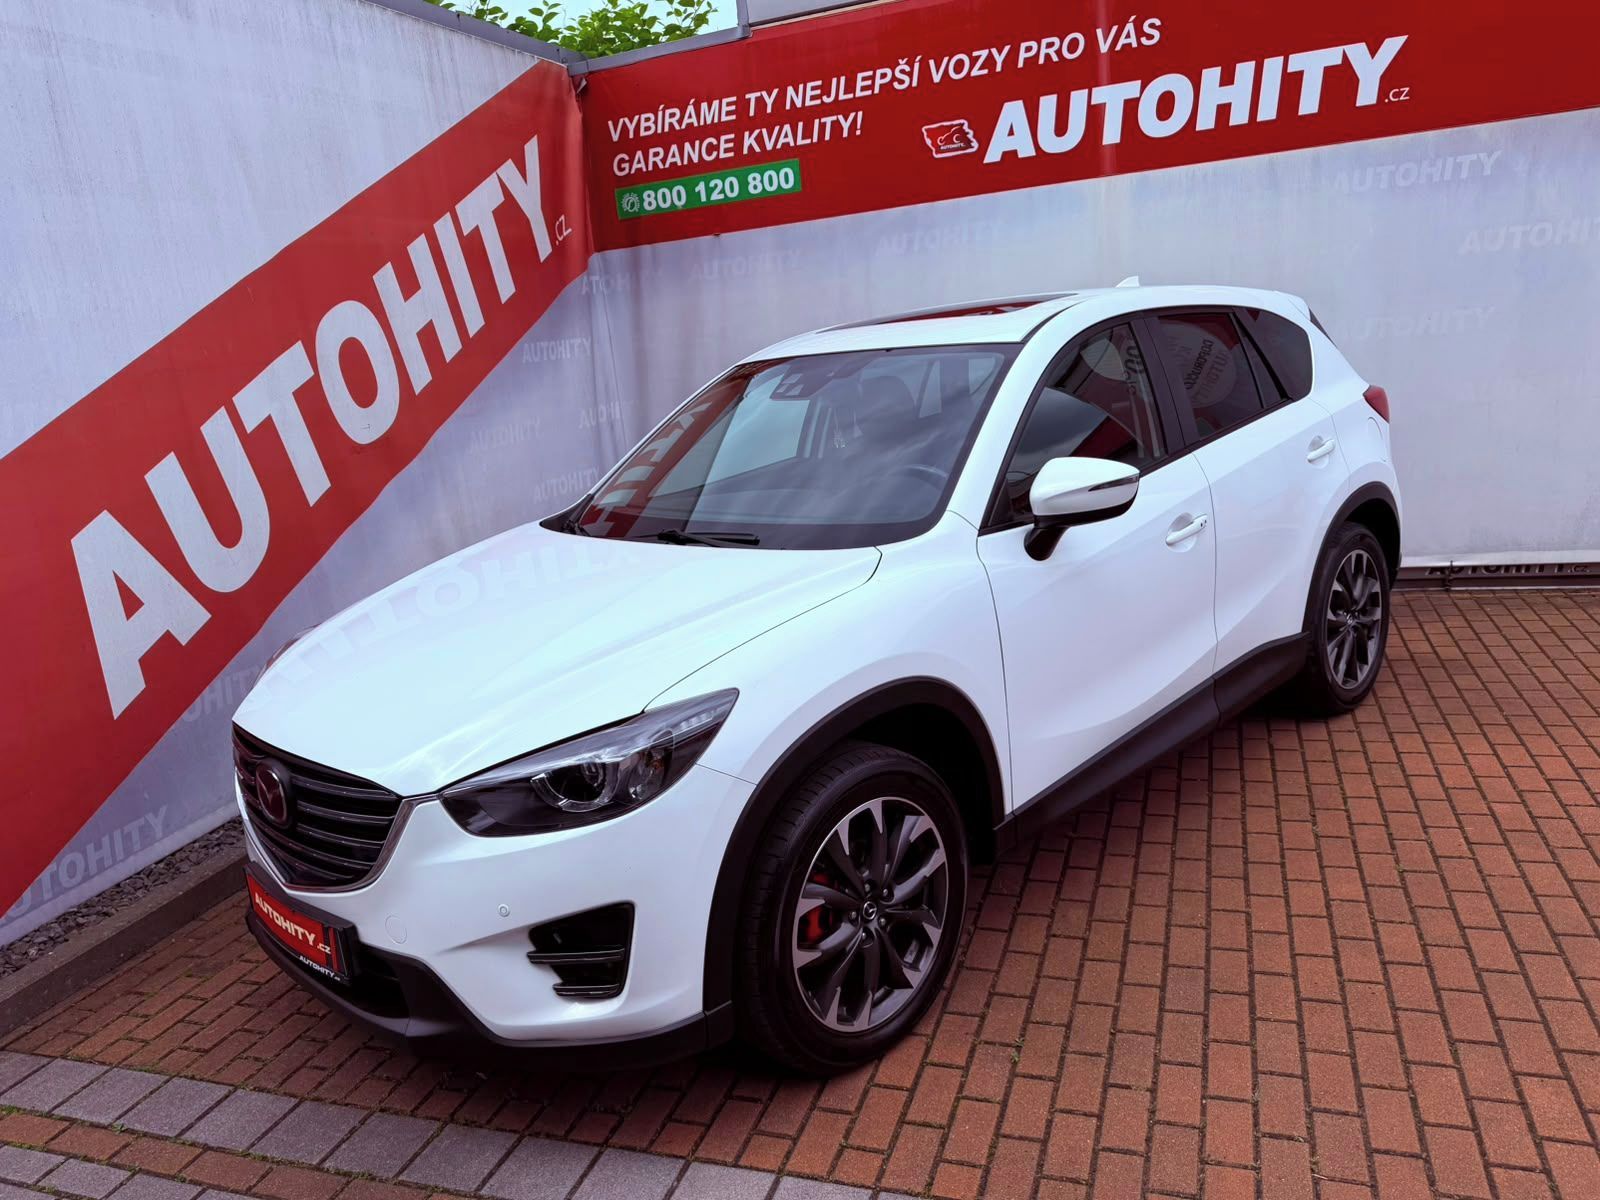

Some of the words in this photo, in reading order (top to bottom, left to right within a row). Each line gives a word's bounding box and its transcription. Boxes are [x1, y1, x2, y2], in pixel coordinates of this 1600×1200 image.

[608, 97, 737, 142] VYBÍRÁME
[746, 88, 779, 117] TY
[785, 55, 922, 110] NEJLEPŠÍ
[929, 44, 1011, 84] VOZY
[1017, 33, 1085, 69] PRO
[1095, 15, 1162, 54] VÁS
[613, 133, 735, 176] GARANCE
[742, 111, 864, 155] KVALITY!
[643, 184, 687, 211] 800
[694, 176, 740, 203] 120
[748, 167, 795, 195] 800
[1334, 150, 1504, 194] AUTOHITY
[521, 336, 592, 364] AUTOHITY
